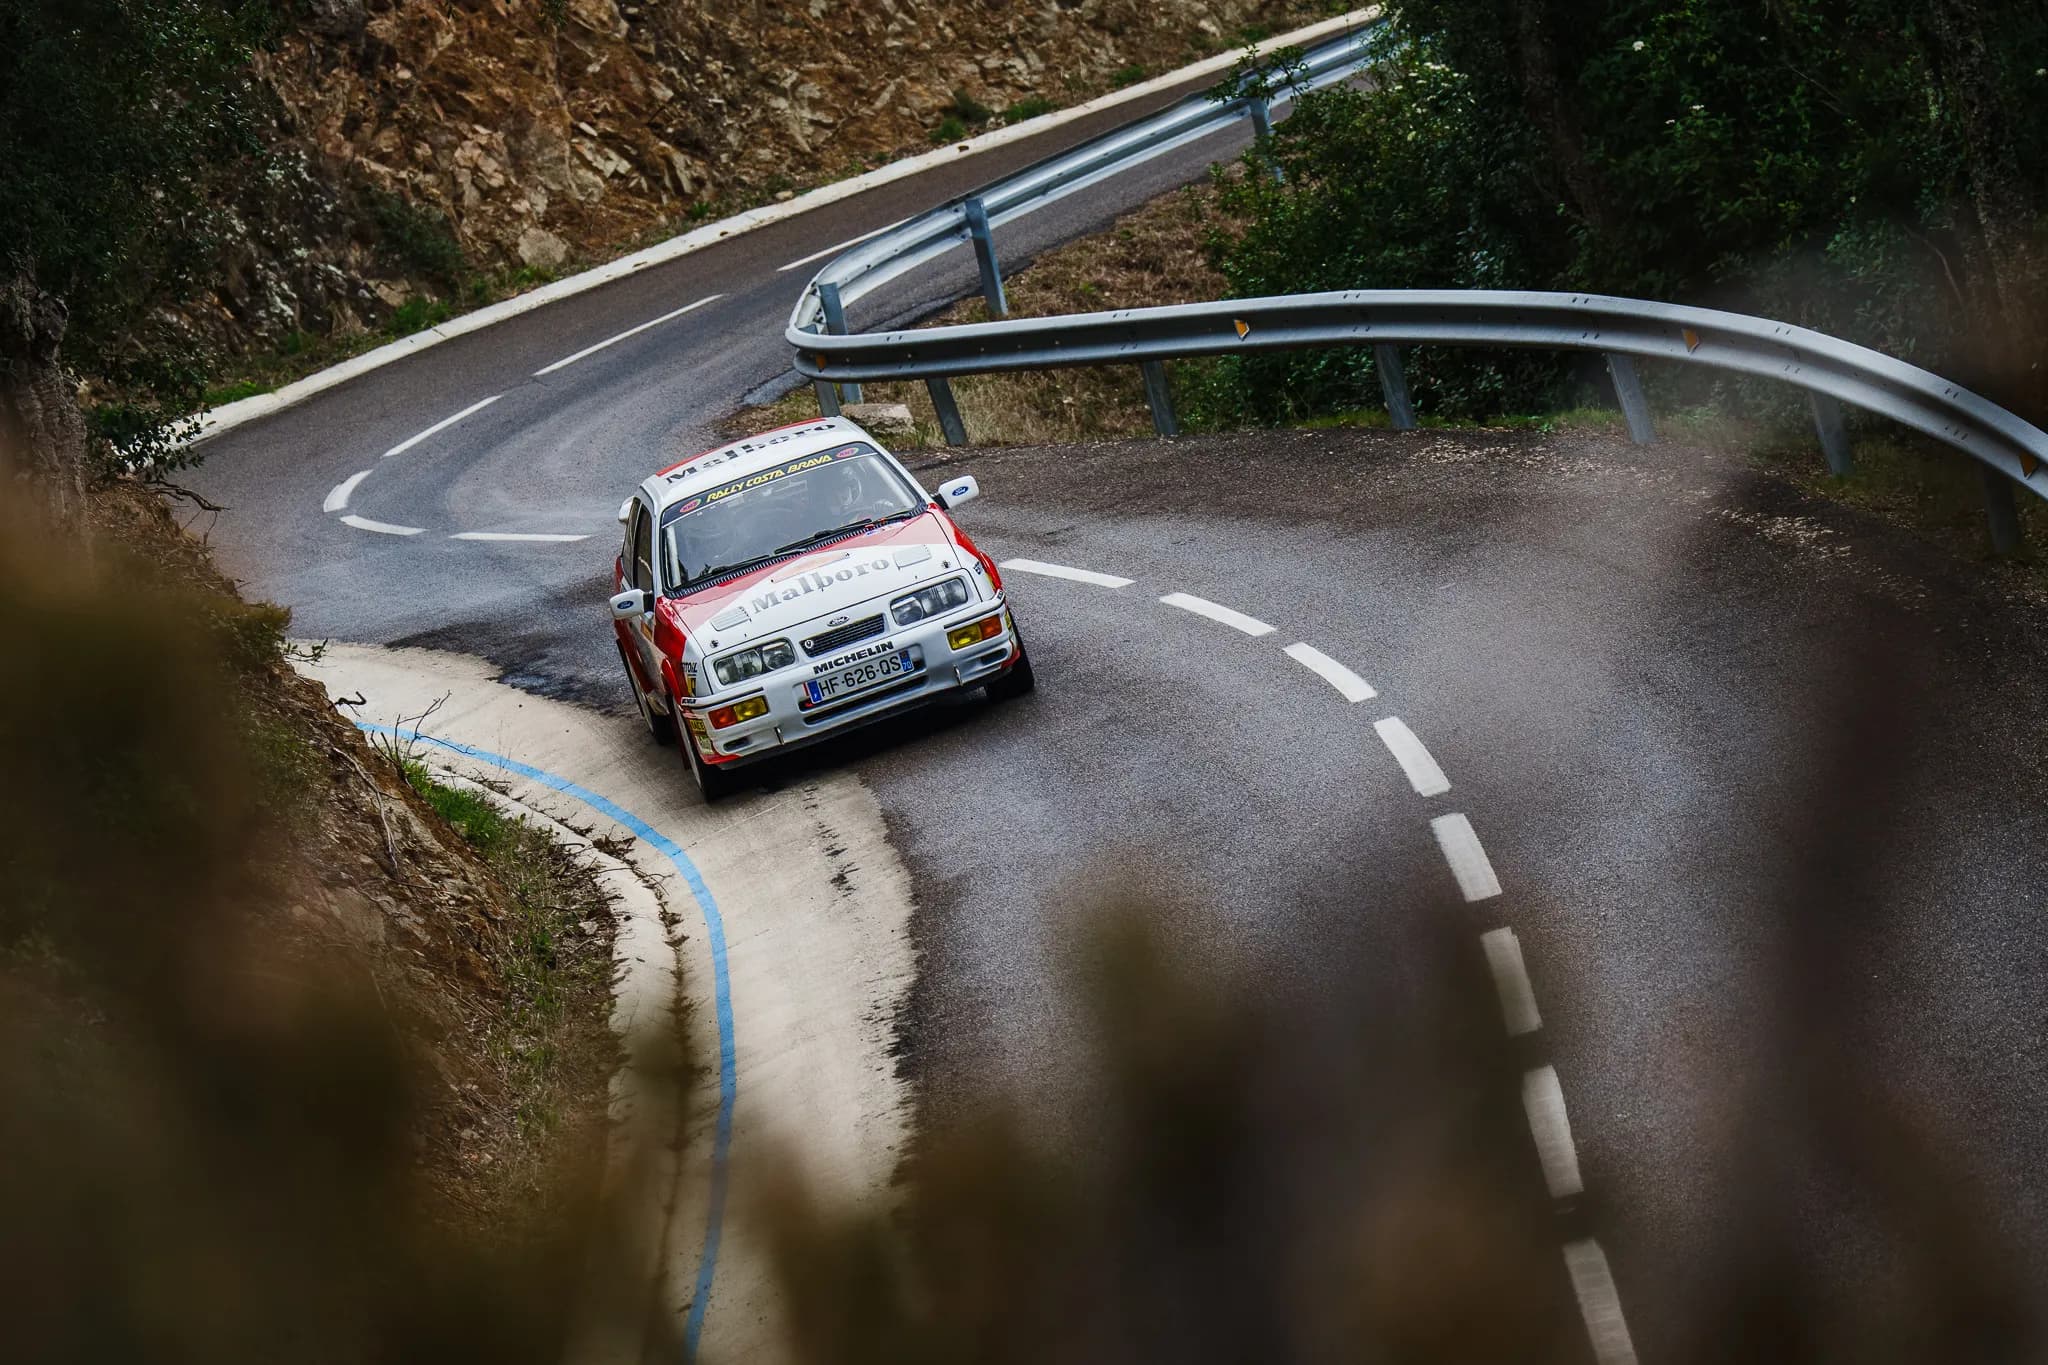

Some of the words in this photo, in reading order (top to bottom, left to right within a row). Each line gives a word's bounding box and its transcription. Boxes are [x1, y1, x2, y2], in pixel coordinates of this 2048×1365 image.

[706, 482, 744, 503] RALLY
[745, 469, 785, 488] COSTA
[786, 454, 833, 474] BRAVA
[752, 560, 889, 614] Malboro
[813, 641, 894, 675] MICHELIN
